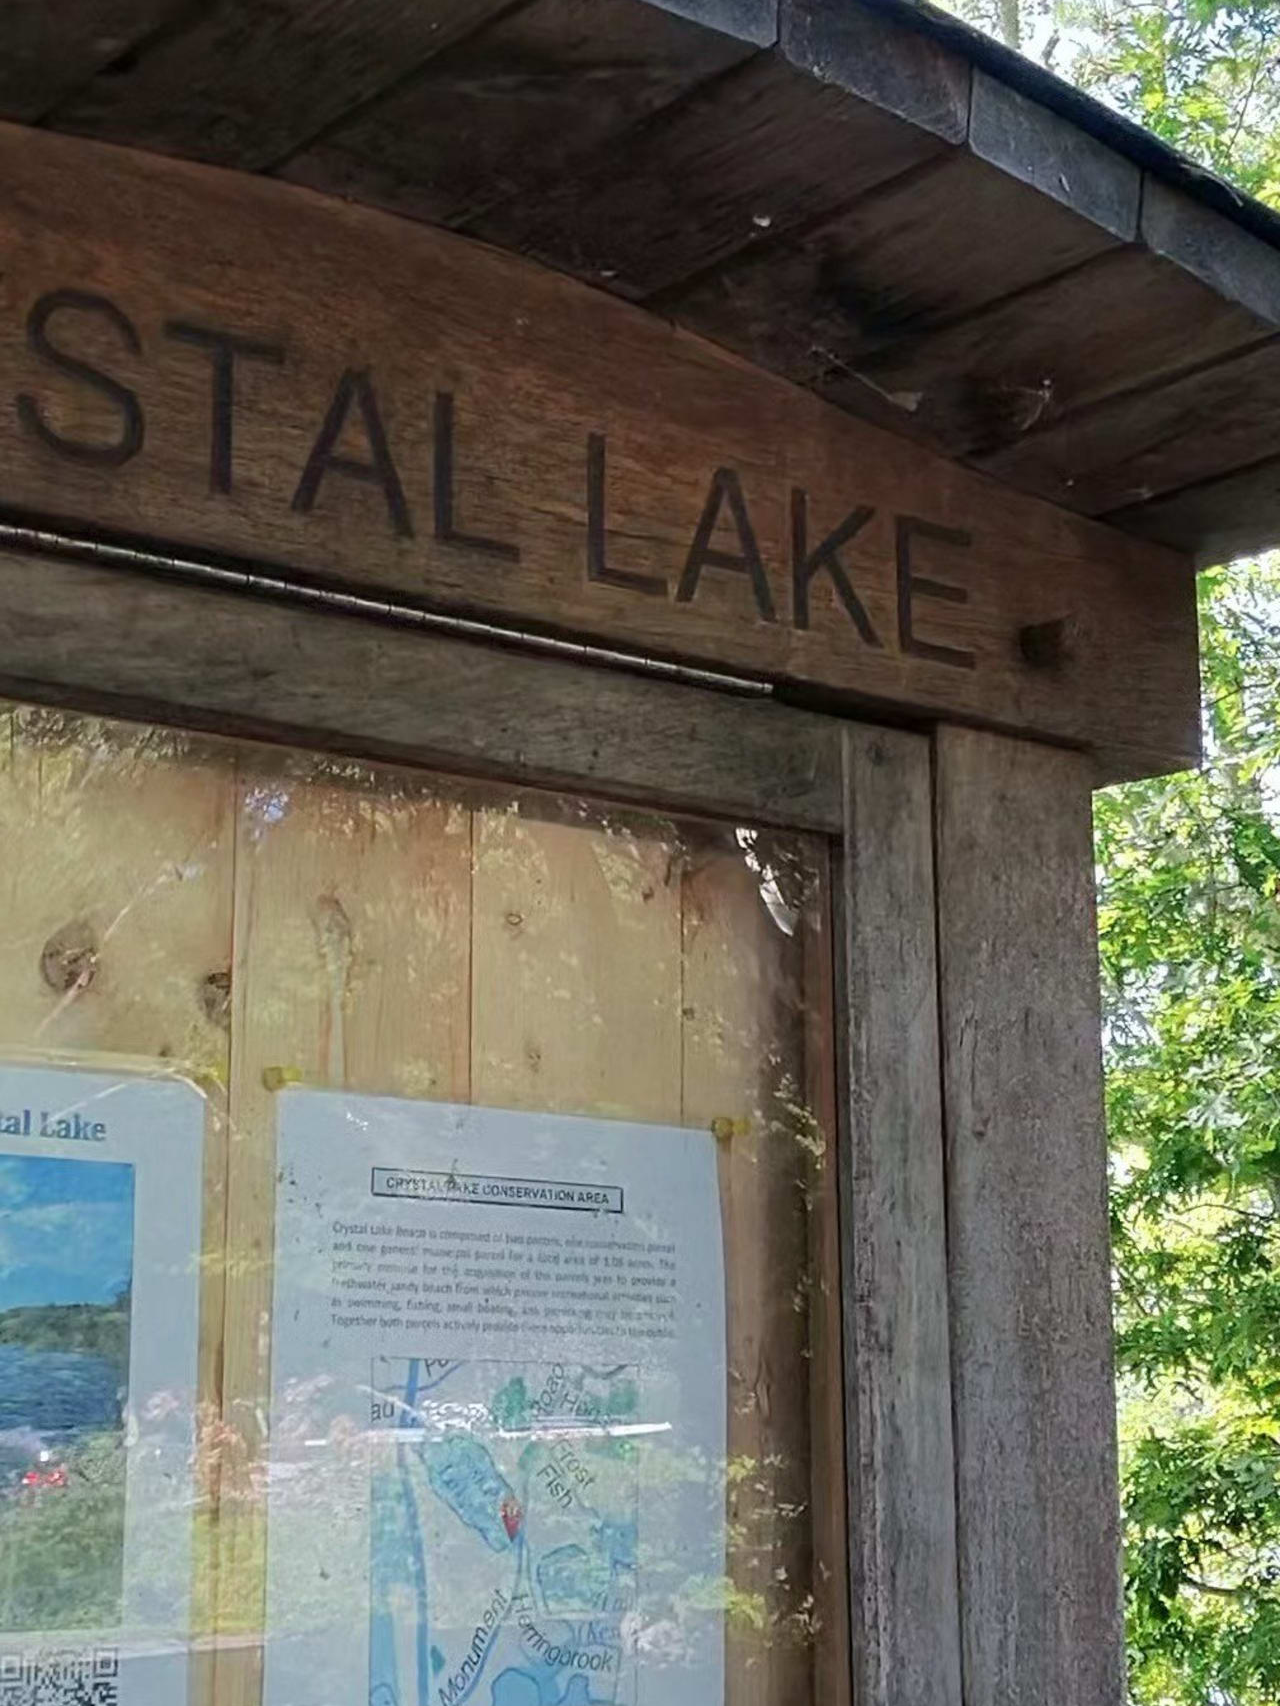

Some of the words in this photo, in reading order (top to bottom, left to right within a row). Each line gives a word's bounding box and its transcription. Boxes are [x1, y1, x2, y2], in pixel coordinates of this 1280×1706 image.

[582, 431, 976, 670] LAKE
[40, 1110, 107, 1142] Lake
[386, 1176, 445, 1192] CRYSTAL
[482, 1184, 575, 1202] CONSERVATION
[577, 1190, 610, 1205] AREA
[333, 1221, 367, 1235] Crystal
[536, 1464, 573, 1509] Fish
[511, 1592, 614, 1673] Herringbrook
